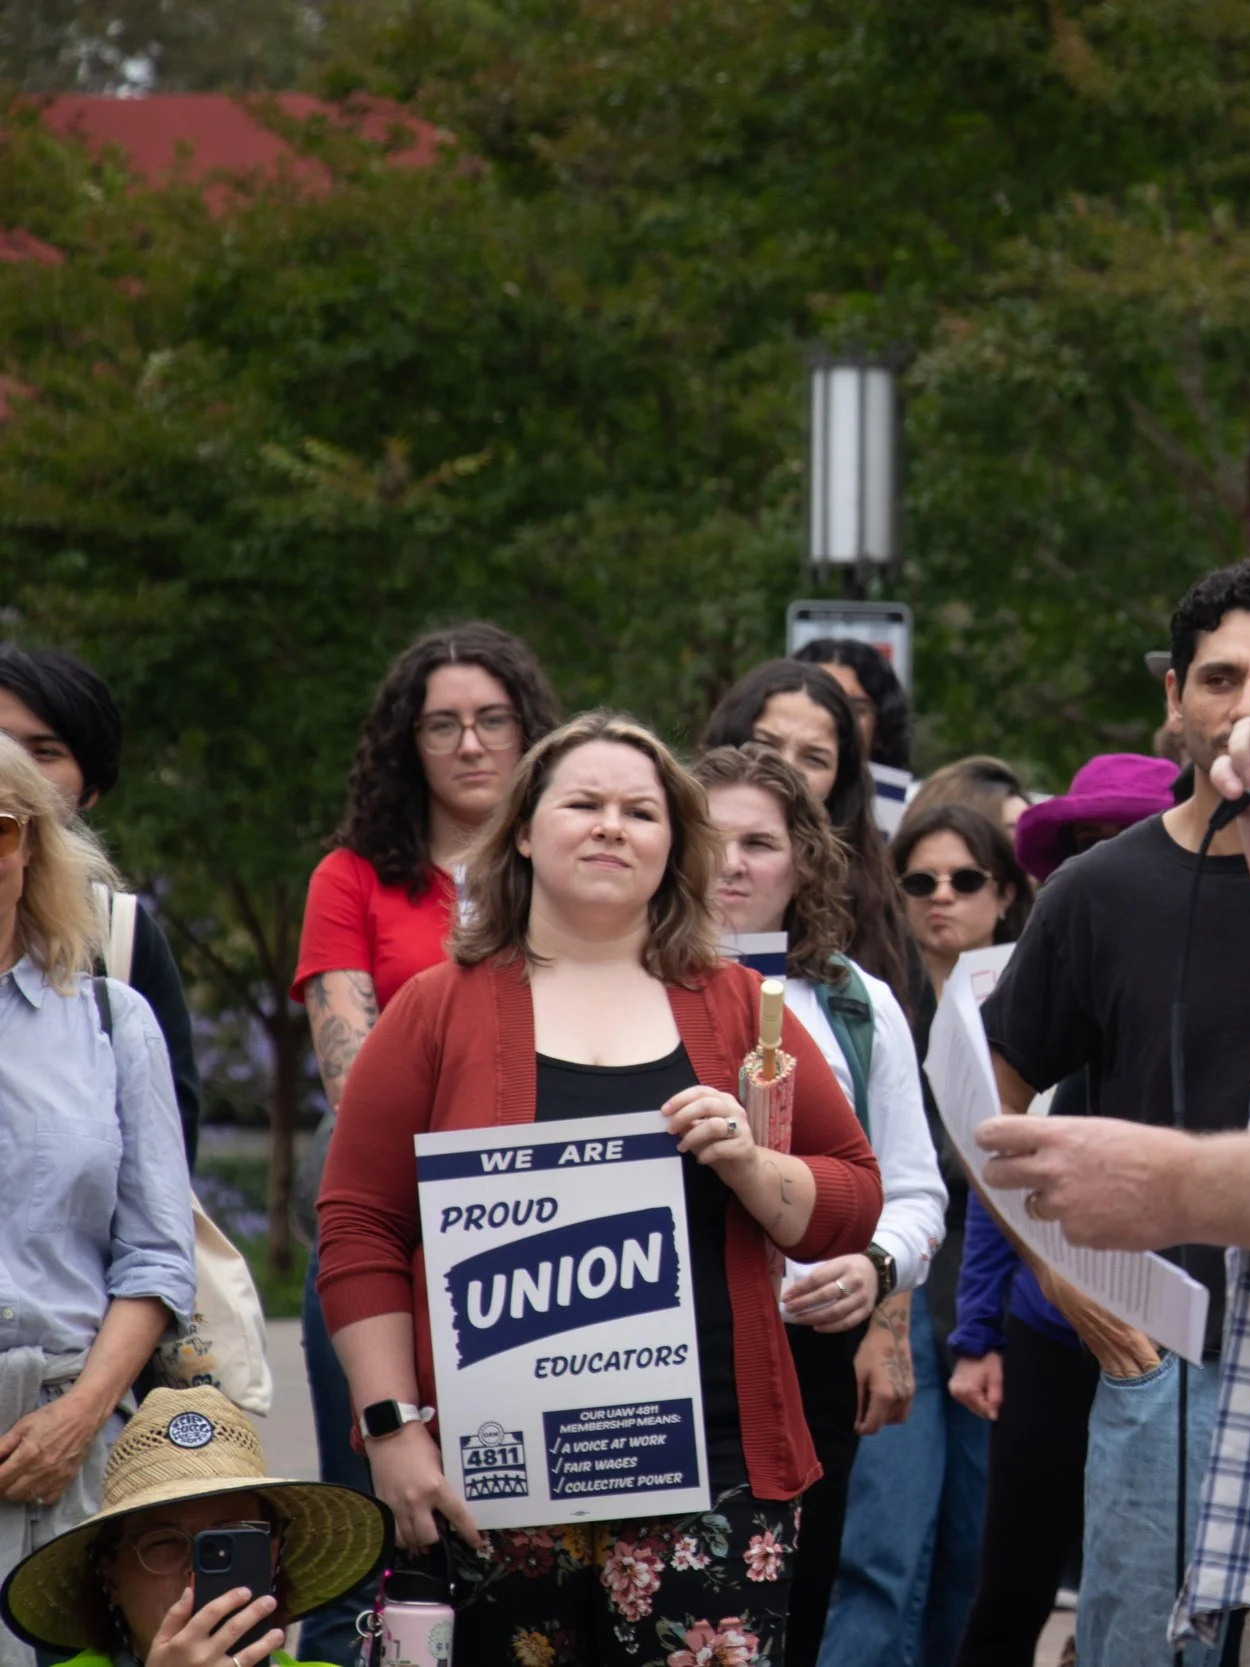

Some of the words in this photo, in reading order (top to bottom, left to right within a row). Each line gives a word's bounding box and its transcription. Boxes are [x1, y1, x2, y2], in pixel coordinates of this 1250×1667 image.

[480, 1149, 533, 1171] WE
[558, 1140, 624, 1164] ARE
[440, 1197, 558, 1233] PROUD
[467, 1232, 662, 1329] UNION
[534, 1344, 688, 1378] EDUCATORS
[580, 1410, 605, 1421] OUR
[606, 1407, 634, 1418] UAW
[636, 1404, 659, 1415] 4811
[560, 1418, 636, 1433] MEMBERSHIP
[637, 1414, 681, 1426] MEANS:
[561, 1443, 571, 1453] A
[573, 1440, 608, 1451] VOICE
[610, 1438, 627, 1449] AT
[629, 1434, 667, 1447] WORK
[467, 1447, 518, 1466] 4811
[564, 1461, 592, 1473] FAIR
[595, 1456, 638, 1470] WAGES
[565, 1477, 634, 1493] COLLECTIVE
[637, 1472, 683, 1486] POWER
